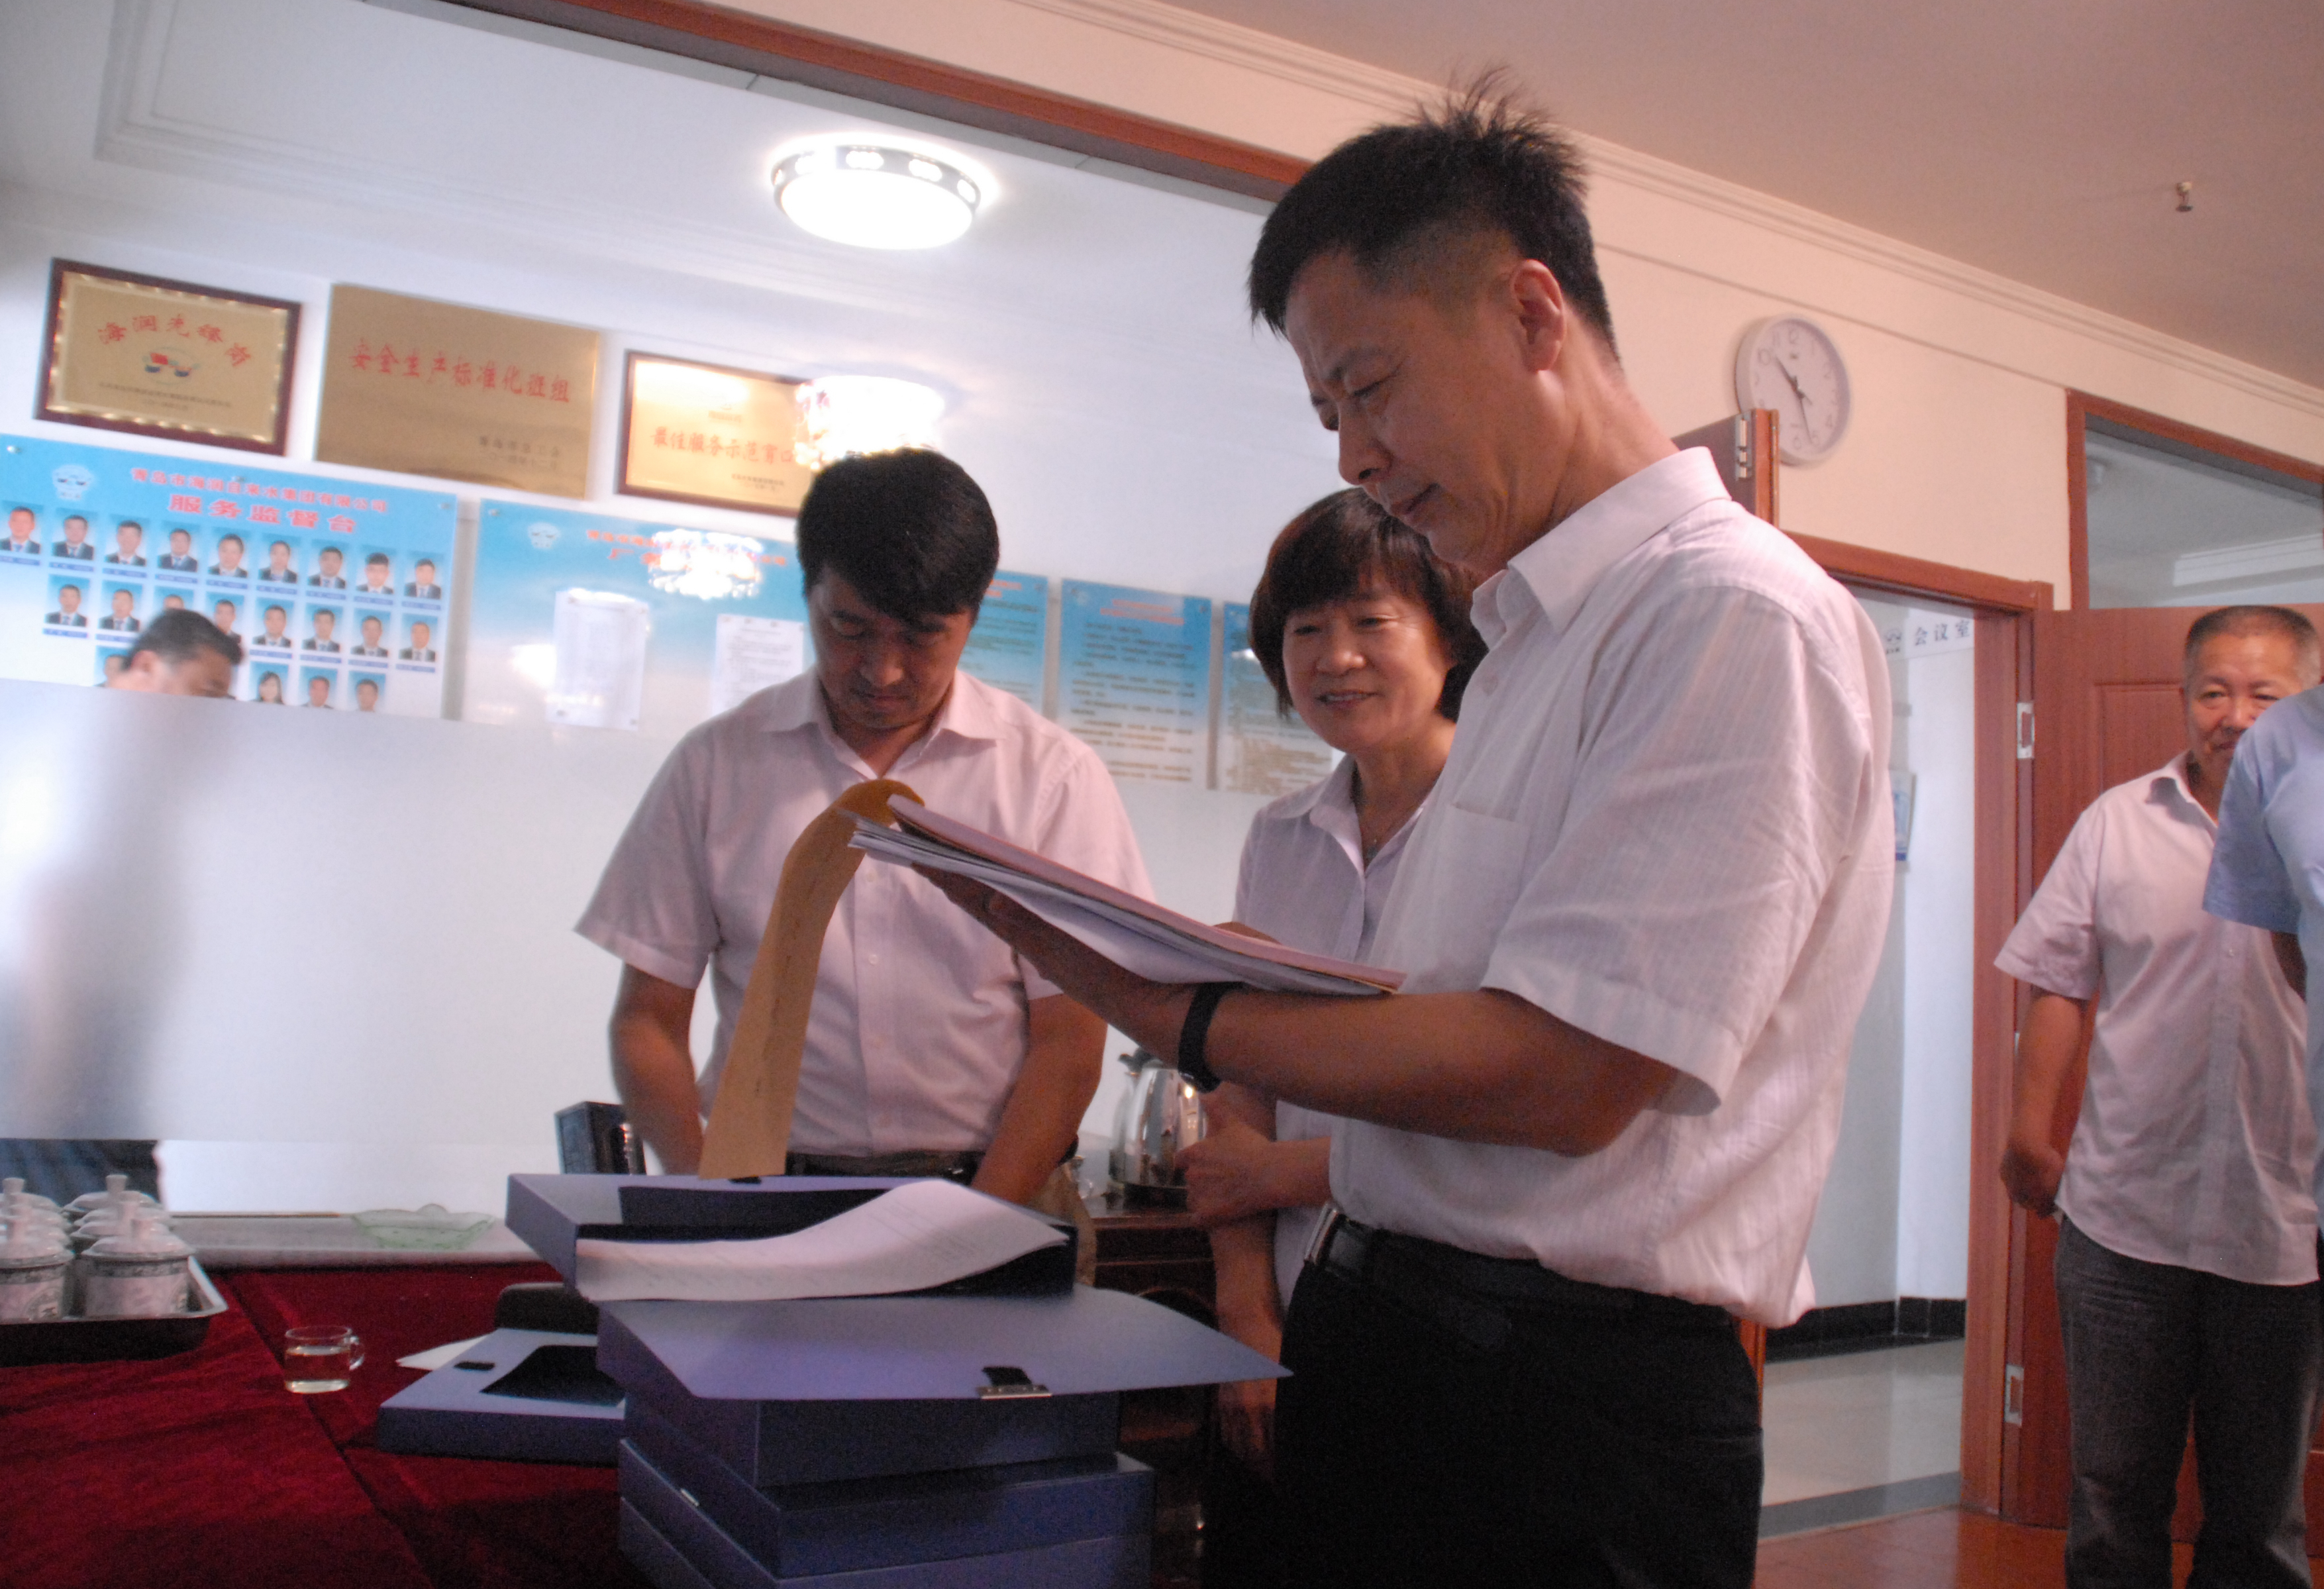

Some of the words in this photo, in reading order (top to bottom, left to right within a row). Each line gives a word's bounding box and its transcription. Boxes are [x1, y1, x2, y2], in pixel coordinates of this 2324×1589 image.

[650, 425, 795, 465] 最佳服务示范窗口
[130, 467, 387, 513] 青岛市海润自来水集团有限公司
[168, 493, 356, 533] 服务监督台
[1915, 619, 1971, 646] 会议室
